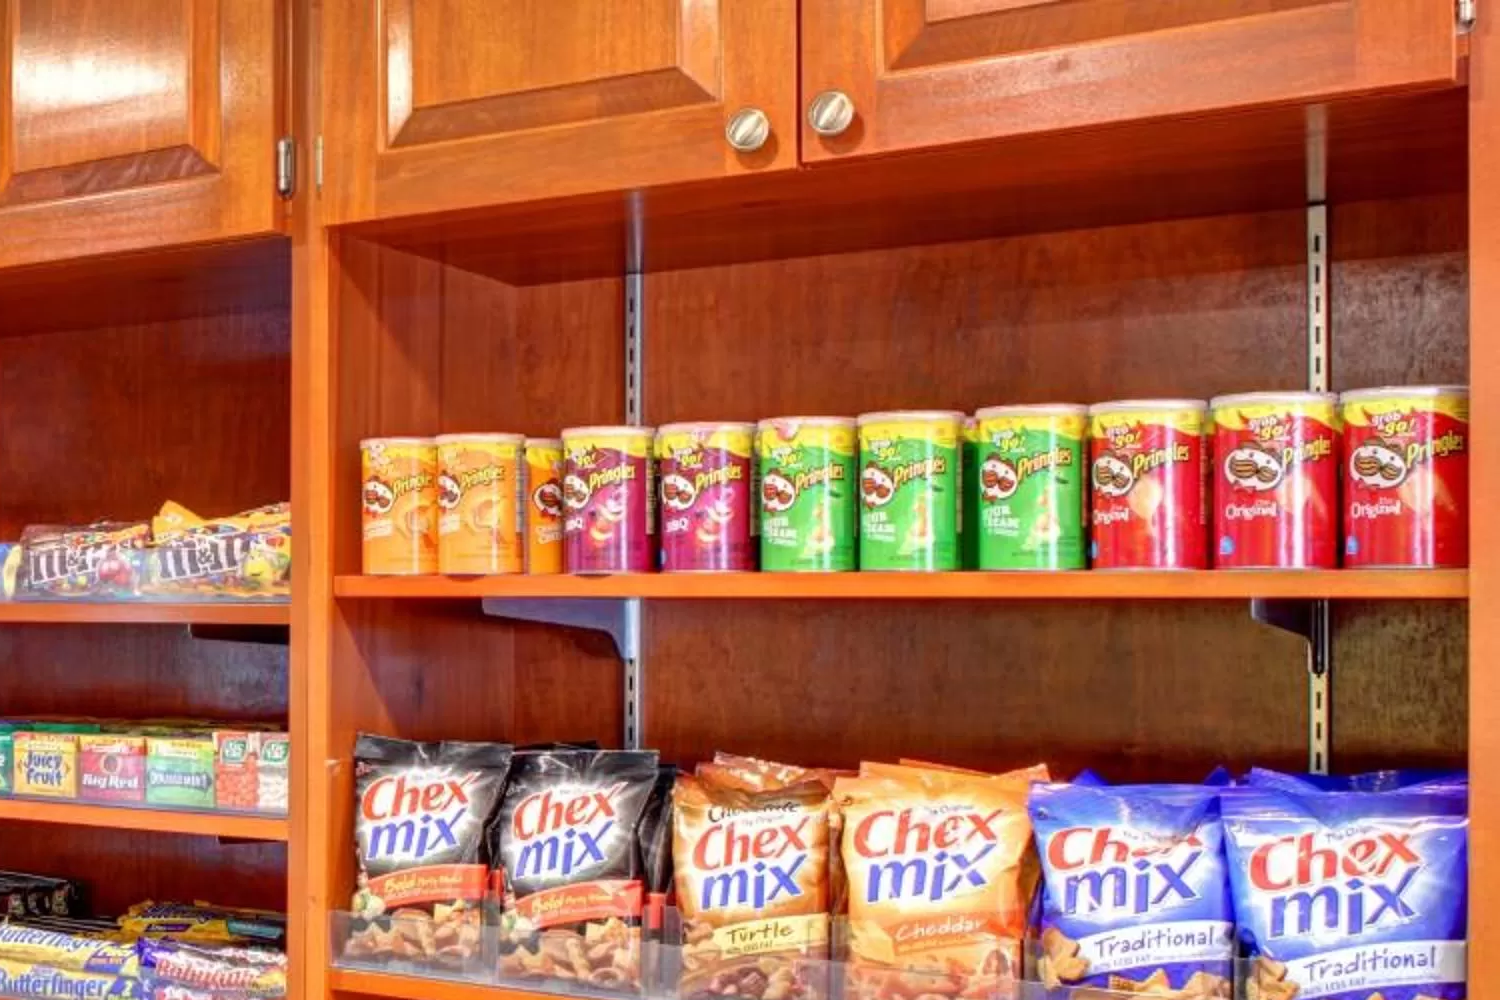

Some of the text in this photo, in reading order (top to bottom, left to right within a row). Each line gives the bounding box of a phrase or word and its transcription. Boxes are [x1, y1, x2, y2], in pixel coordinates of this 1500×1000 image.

[894, 457, 946, 489] Pringles
[1017, 447, 1073, 480] Pringles
[1133, 443, 1189, 478] Pringles
[589, 465, 635, 490] Pringles
[695, 465, 743, 491] Pringles
[795, 463, 844, 494] Pringles
[666, 517, 688, 533] BBQ
[1225, 502, 1277, 520] Original
[1351, 502, 1401, 520] Original
[24, 750, 63, 772] Juicy
[26, 769, 62, 786] Fruit
[82, 773, 139, 789] Big Red
[361, 771, 481, 823] Chex
[512, 781, 628, 841] Chex
[366, 807, 467, 860] mix
[515, 820, 614, 879] mix
[692, 816, 809, 871] Chex
[853, 809, 1004, 858] Chex
[867, 843, 997, 904] mix
[1249, 831, 1421, 892] Chex
[701, 854, 807, 912] mix
[1064, 849, 1202, 915] mix
[1269, 865, 1424, 939] mix
[726, 921, 796, 946] Turtle
[895, 915, 983, 943] Cheddar
[1094, 926, 1215, 959] Traditional
[1303, 945, 1438, 984] Traditional
